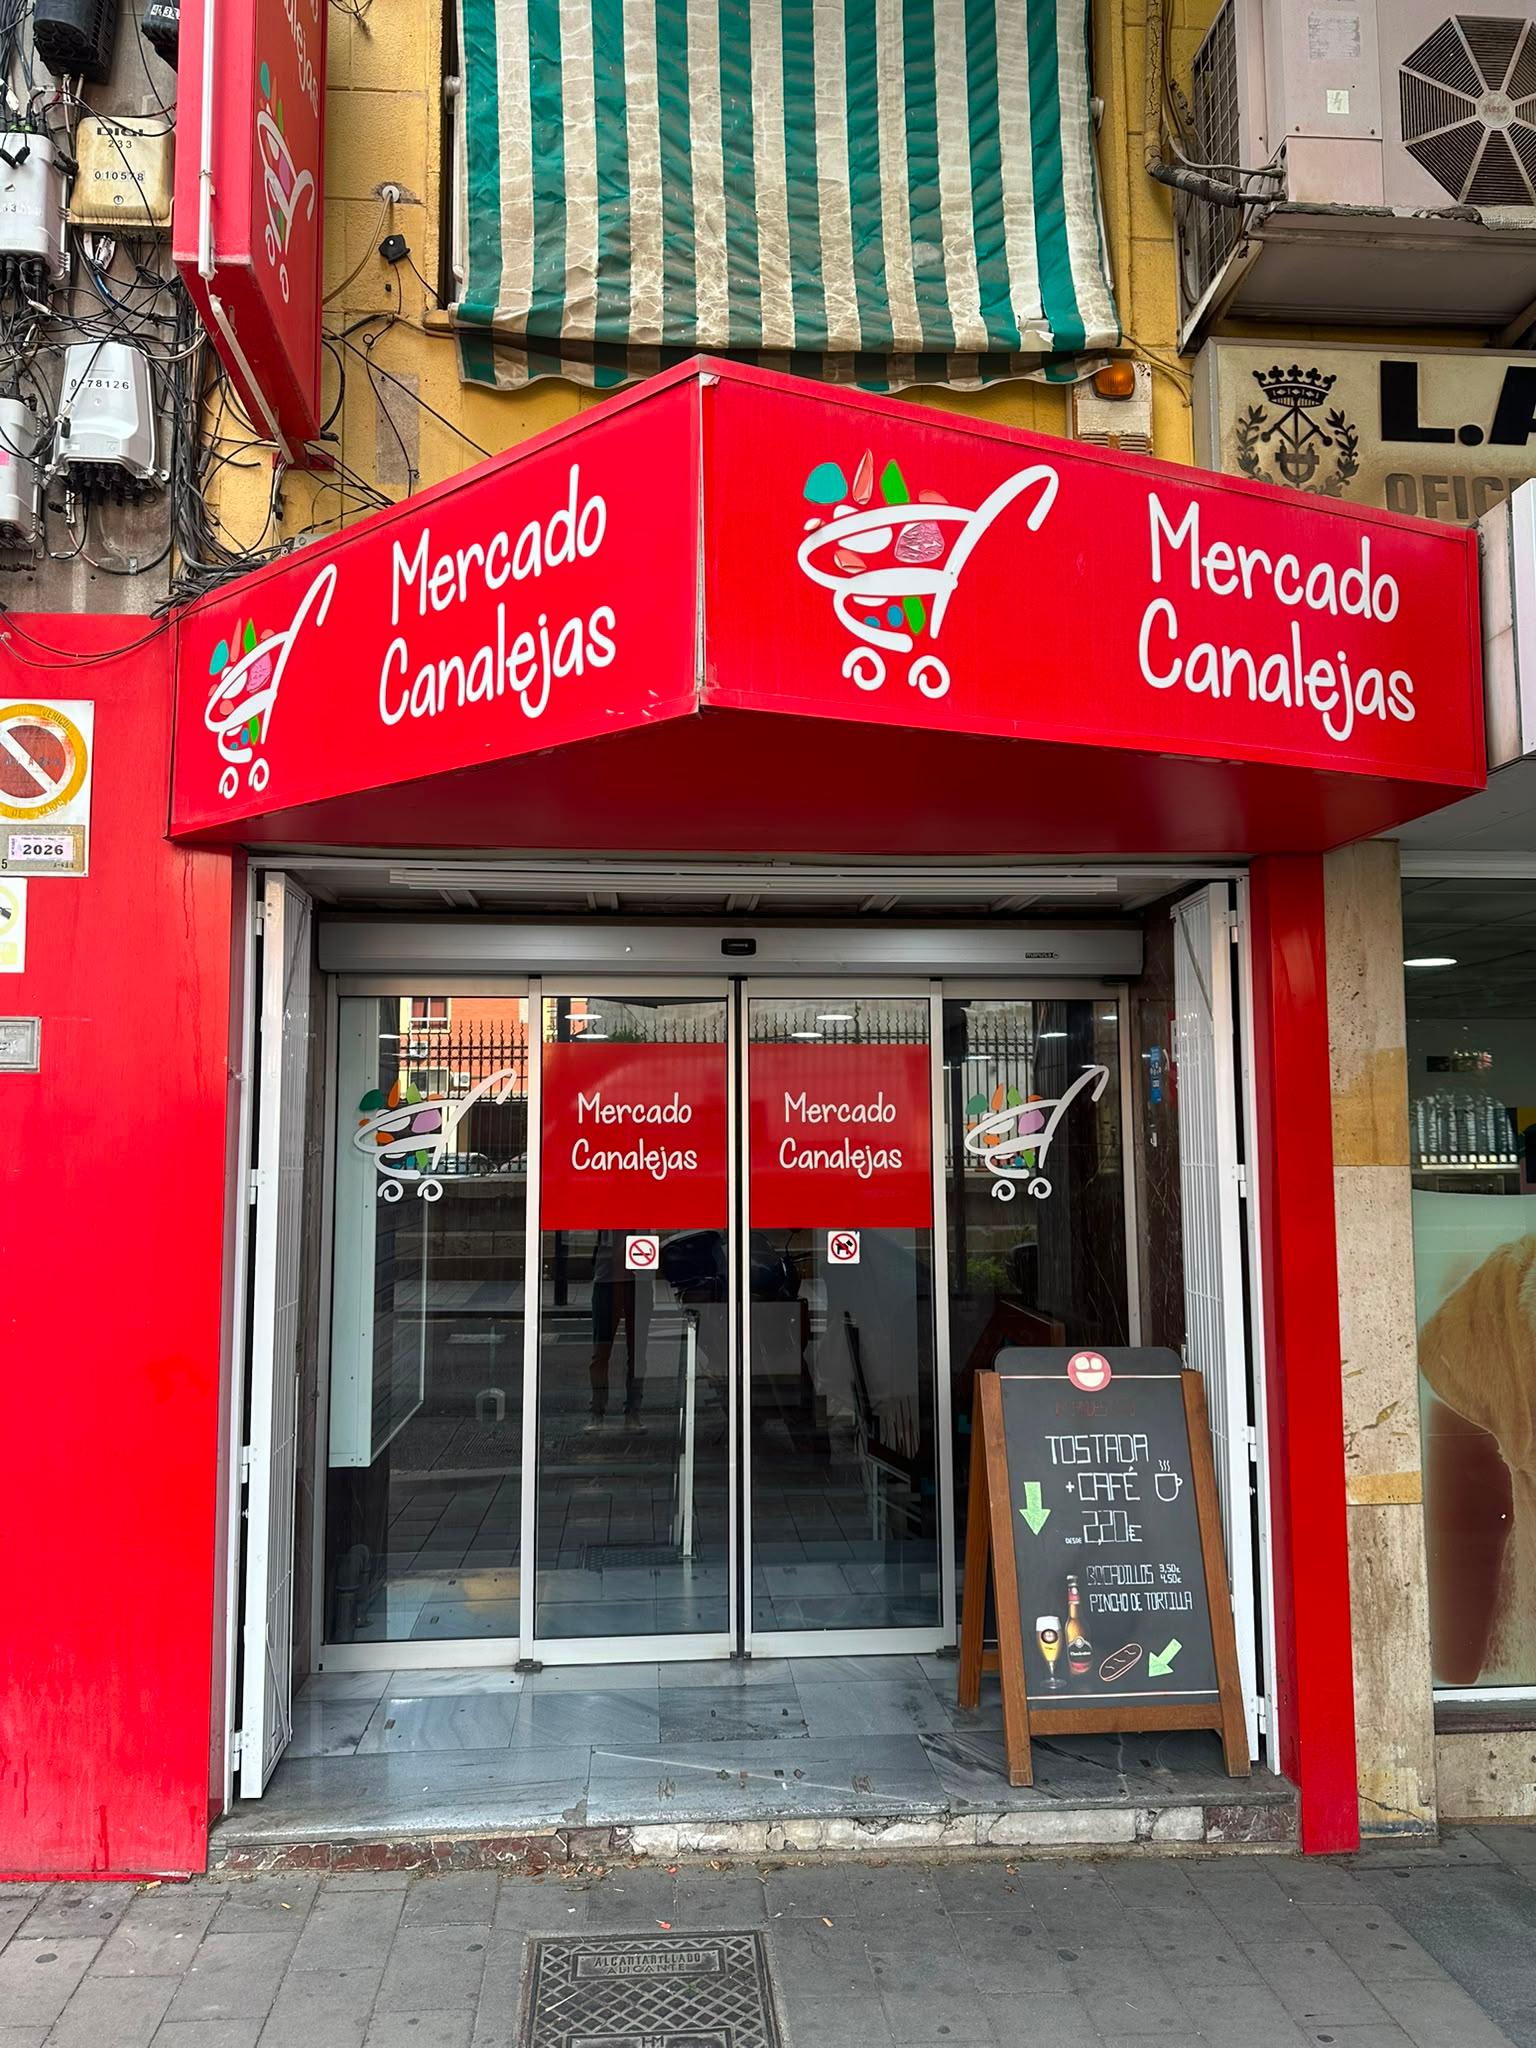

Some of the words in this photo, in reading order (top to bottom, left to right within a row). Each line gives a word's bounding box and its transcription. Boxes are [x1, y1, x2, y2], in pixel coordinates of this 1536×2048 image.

[97, 127, 143, 136] DIGI
[108, 140, 132, 148] 233
[392, 464, 607, 625] Mercado
[1149, 493, 1399, 622] Mercado
[380, 606, 615, 726] Canalejas
[1139, 599, 1416, 741] Canalejas
[22, 844, 64, 856] 2026
[578, 1092, 692, 1124] Mercado
[784, 1091, 896, 1124] Mercado
[571, 1138, 698, 1181] Canalejas
[779, 1137, 903, 1179] Canalejas
[1045, 1433, 1149, 1465] TOSTADA
[1078, 1466, 1141, 1501] CAFÉ
[1086, 1564, 1154, 1585] BOCADILLOS
[1089, 1593, 1129, 1612] PINCHO
[1131, 1592, 1143, 1611] DE
[1144, 1591, 1193, 1611] TORTILLA
[593, 1952, 701, 1967] ALCANTARILLADO
